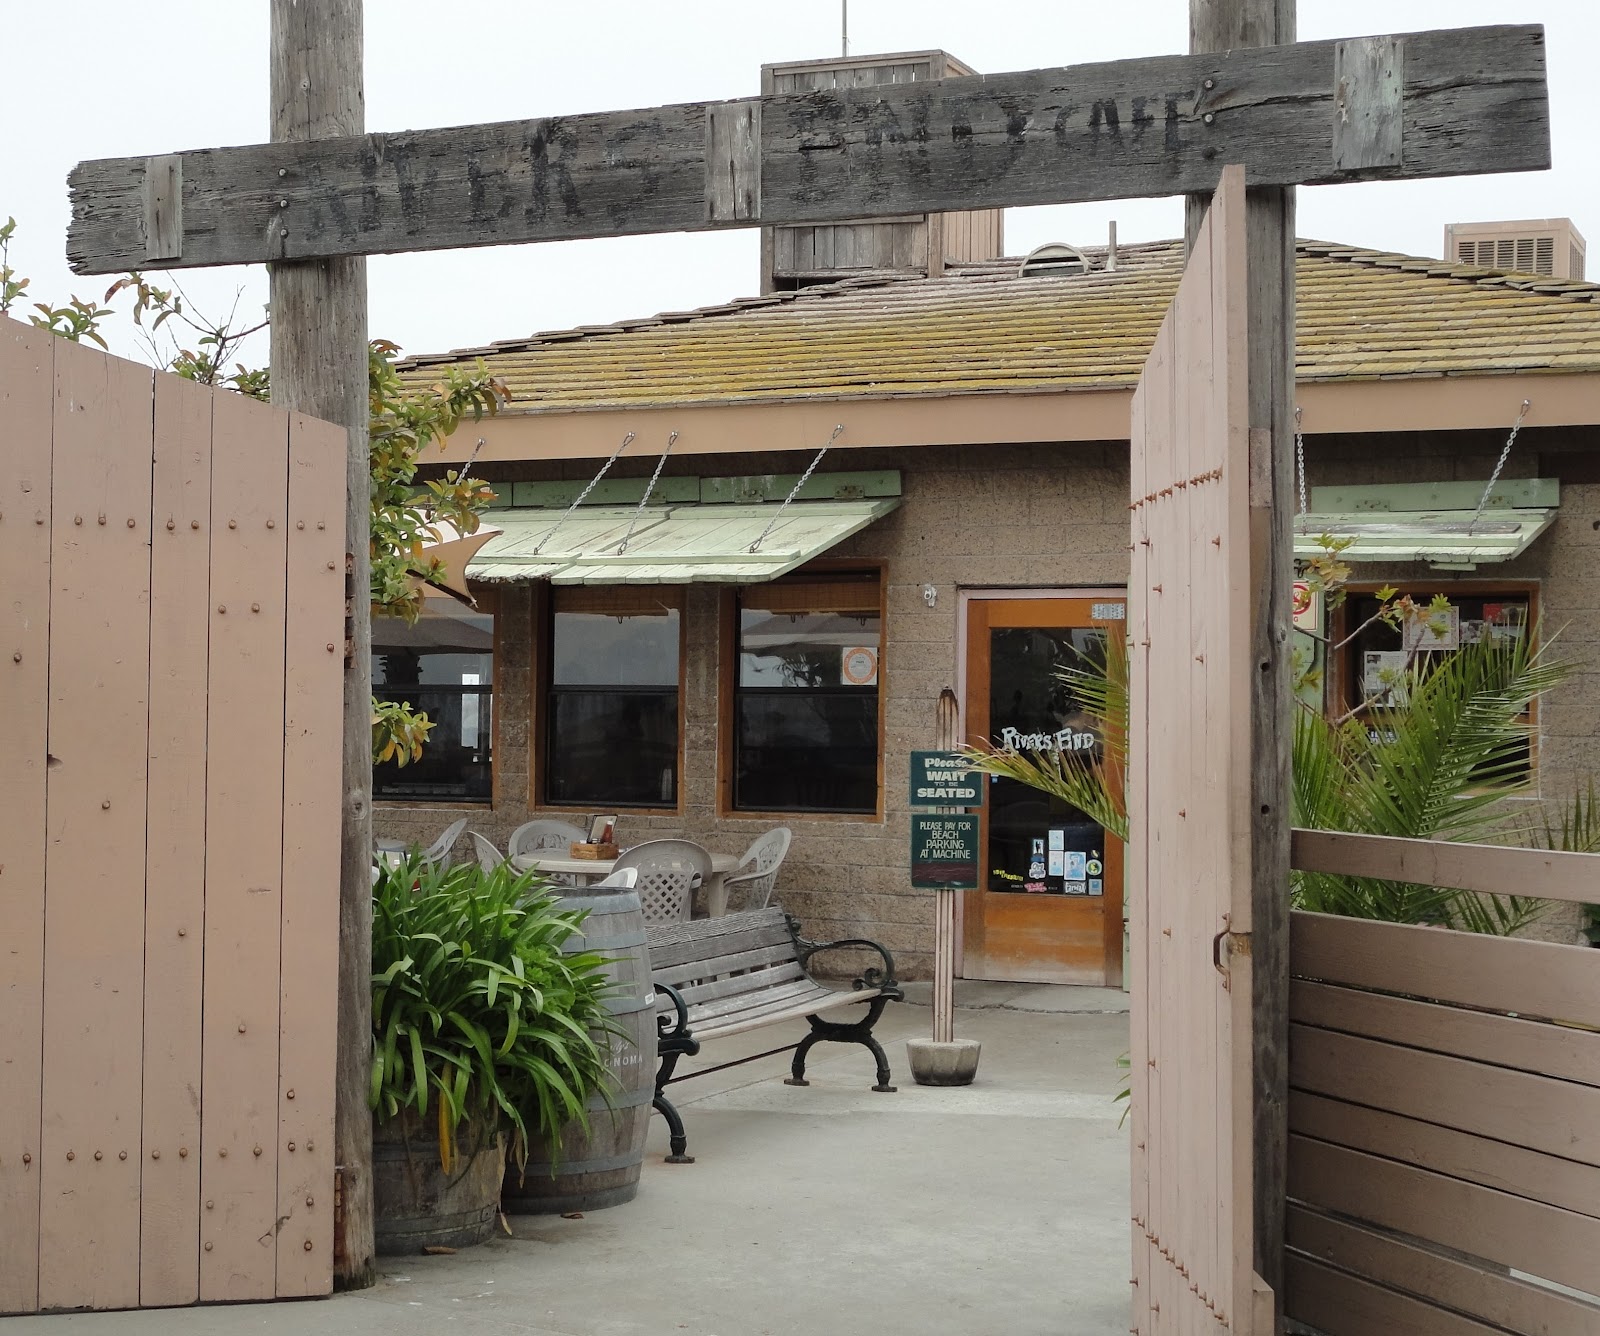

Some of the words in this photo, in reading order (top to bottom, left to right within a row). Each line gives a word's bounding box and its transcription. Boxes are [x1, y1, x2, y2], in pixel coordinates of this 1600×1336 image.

[926, 771, 968, 782] WAIT
[917, 787, 976, 798] SEATED
[919, 821, 943, 831] PLEASE
[944, 821, 957, 831] PAY
[958, 821, 972, 831] FOR
[931, 830, 959, 840] BEACH
[926, 839, 965, 850] PARKING
[919, 849, 930, 859] AT
[932, 849, 971, 859] MACHINE
